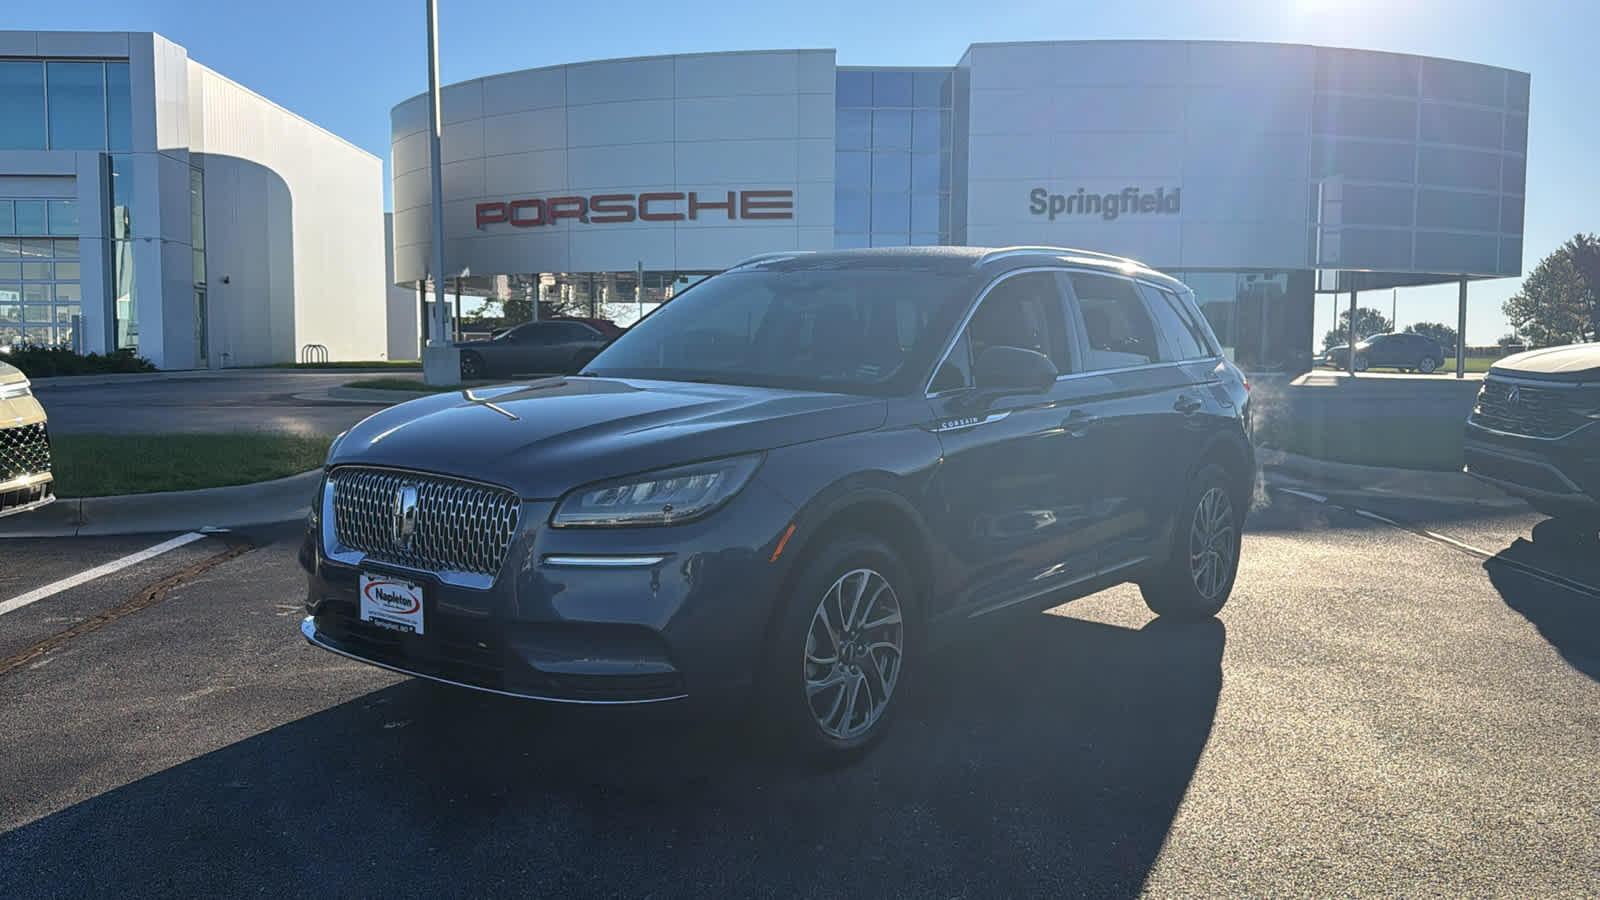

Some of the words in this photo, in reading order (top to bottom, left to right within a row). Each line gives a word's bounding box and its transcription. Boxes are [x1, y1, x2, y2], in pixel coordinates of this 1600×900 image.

[475, 190, 793, 229] PORSCHE
[1030, 187, 1181, 221] Springfield
[941, 417, 978, 428] CORSAIR
[375, 587, 412, 607] Napleton
